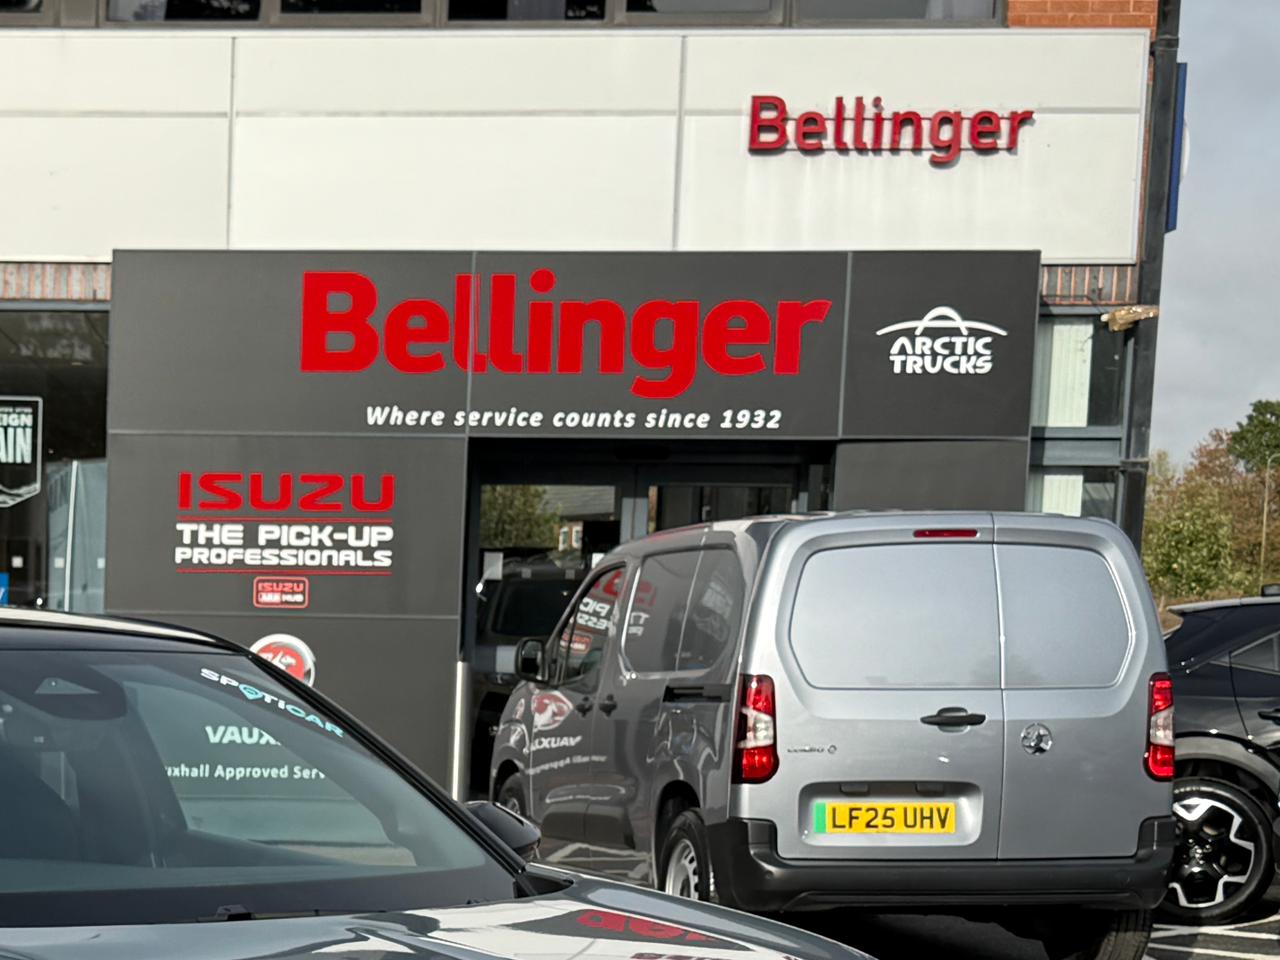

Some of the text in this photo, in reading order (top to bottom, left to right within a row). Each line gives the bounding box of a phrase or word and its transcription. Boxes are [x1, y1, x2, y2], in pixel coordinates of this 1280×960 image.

[749, 96, 1034, 167] Bellinger
[300, 267, 832, 400] Bellinger
[889, 336, 993, 355] ARCTIC
[889, 355, 993, 374] TRUCKS
[366, 405, 782, 429] Where service counts since 1932
[177, 472, 396, 512] ISUZU
[175, 523, 394, 548] THE PICK-UP
[175, 546, 393, 567] PROFESSIONALS
[258, 582, 304, 592] ISUZU
[205, 725, 282, 746] VAUX
[214, 764, 288, 781] Approved
[831, 807, 951, 830] LF25 UHV
